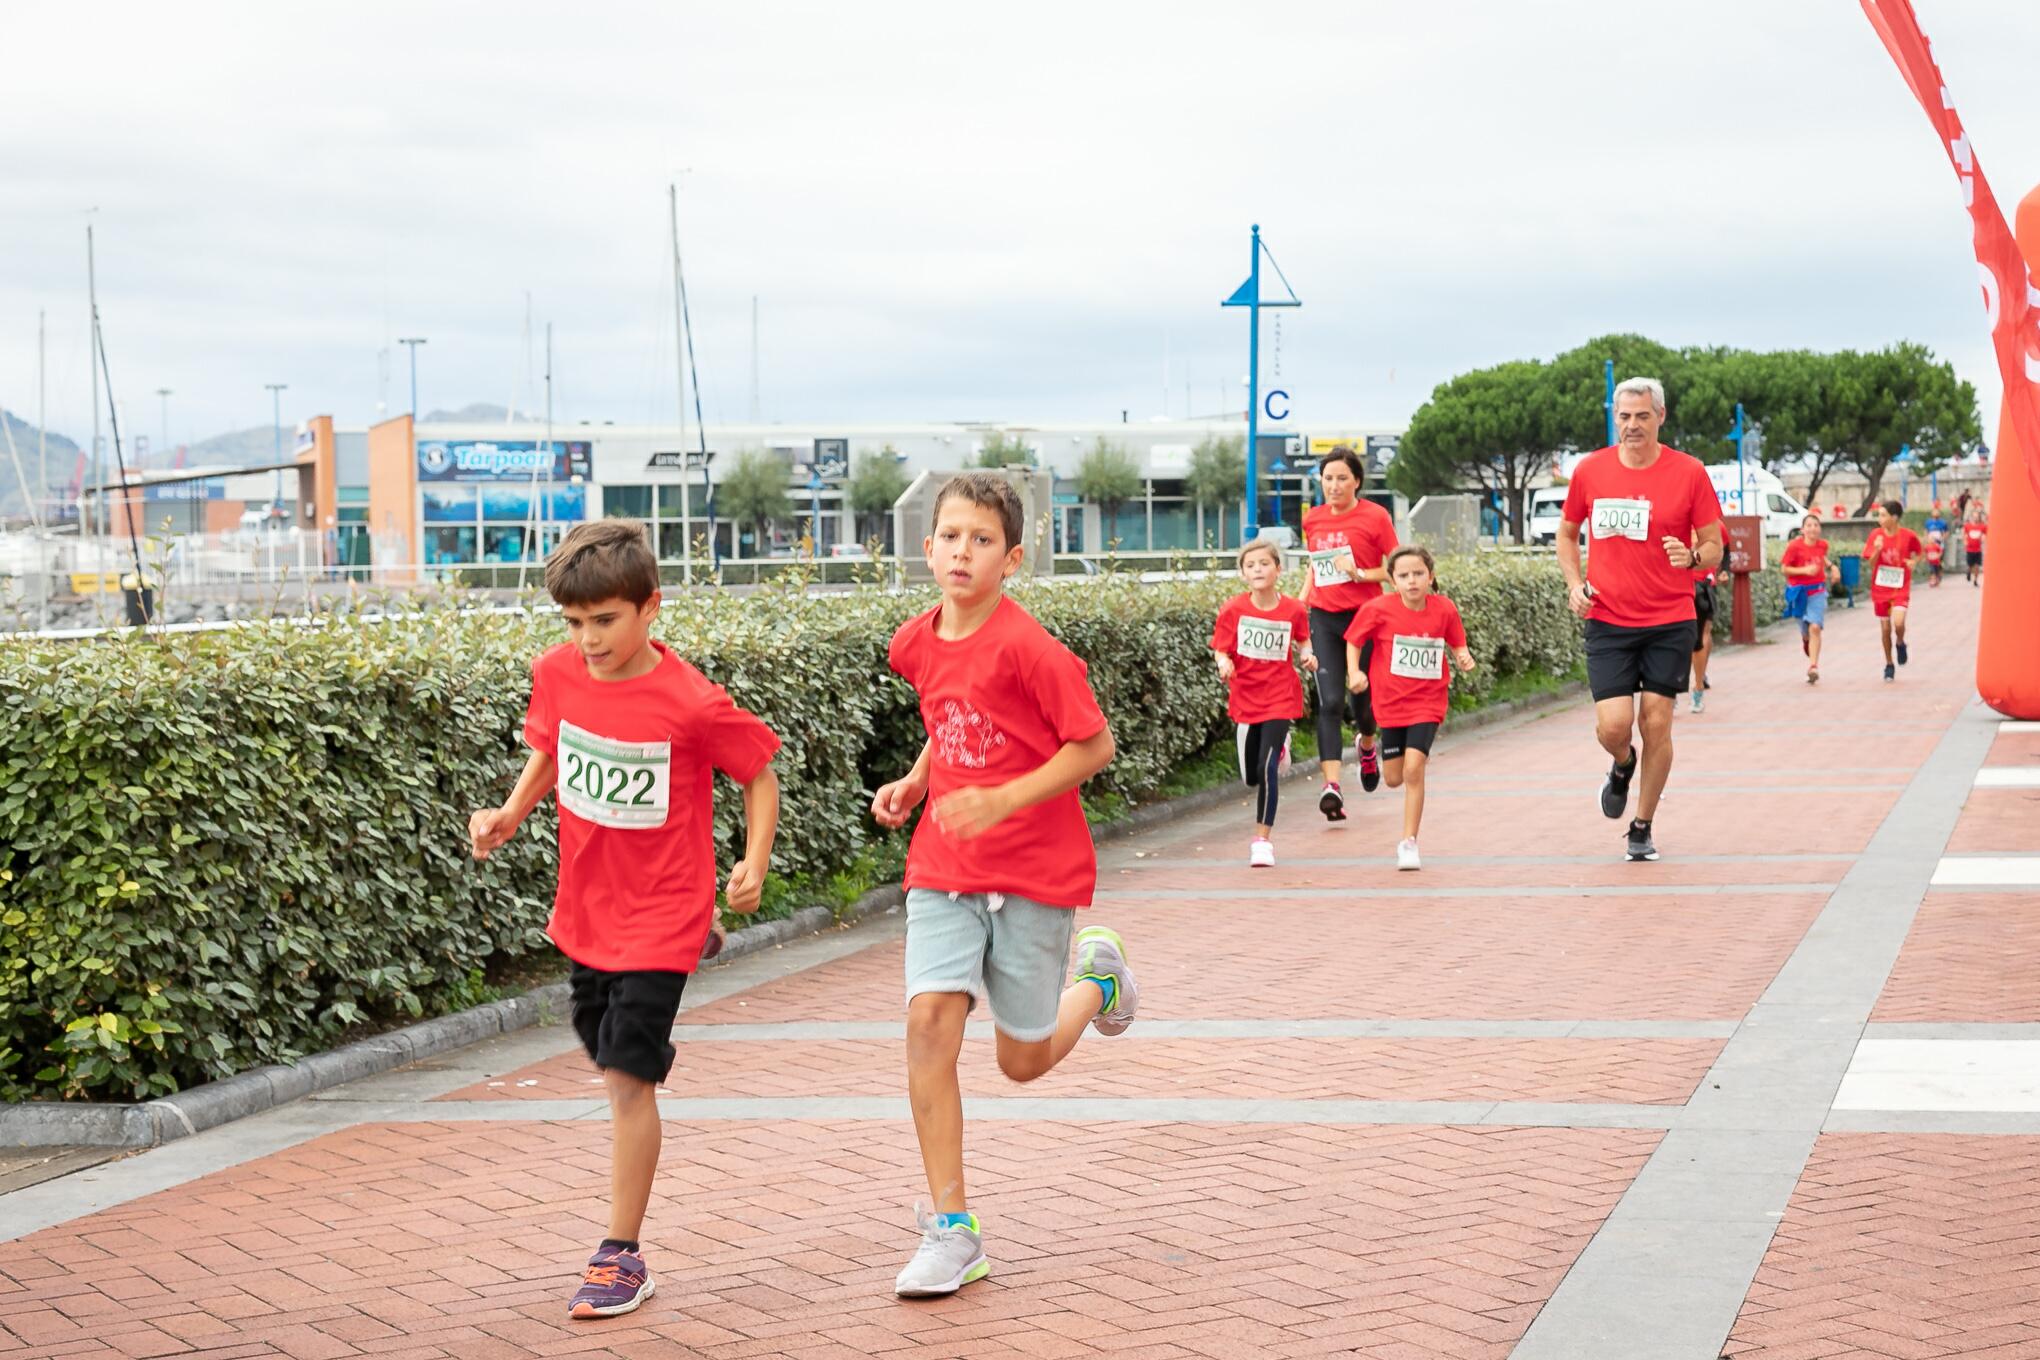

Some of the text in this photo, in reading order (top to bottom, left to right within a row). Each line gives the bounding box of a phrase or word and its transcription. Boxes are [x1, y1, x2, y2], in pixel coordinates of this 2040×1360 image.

[1265, 390, 1289, 420] C
[1746, 473, 1758, 484] A
[1598, 510, 1641, 528] 2004
[1317, 560, 1335, 577] 20
[1243, 628, 1284, 650] 2004
[1399, 647, 1438, 669] 2004
[567, 752, 656, 805] 2022
